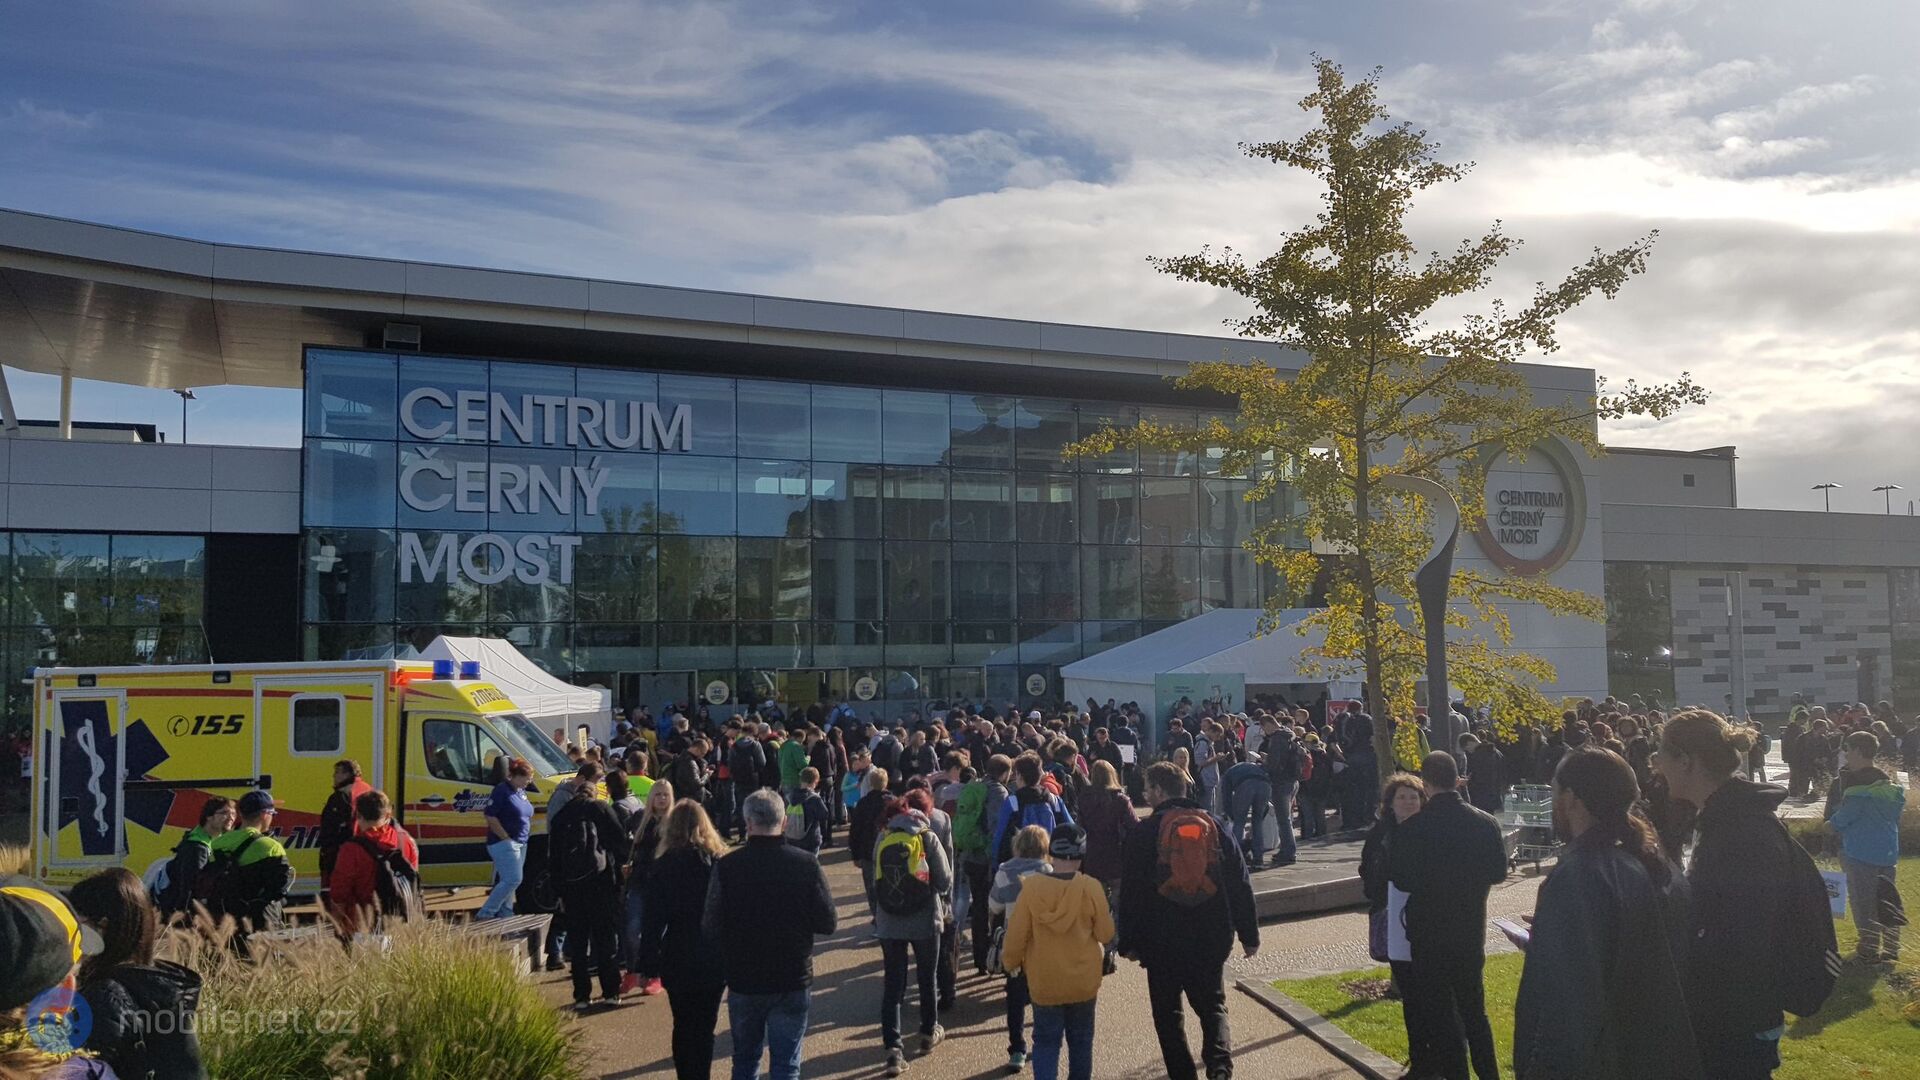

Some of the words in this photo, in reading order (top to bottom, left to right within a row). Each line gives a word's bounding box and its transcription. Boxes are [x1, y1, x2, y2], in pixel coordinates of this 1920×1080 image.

[400, 387, 692, 451] CENTRUM
[399, 447, 610, 515] ČERNÝ
[1497, 490, 1563, 507] CENTRUM
[1497, 507, 1545, 527] ČERNÝ
[1498, 529, 1539, 544] MOST
[400, 532, 582, 585] MOST
[191, 714, 245, 735] 155
